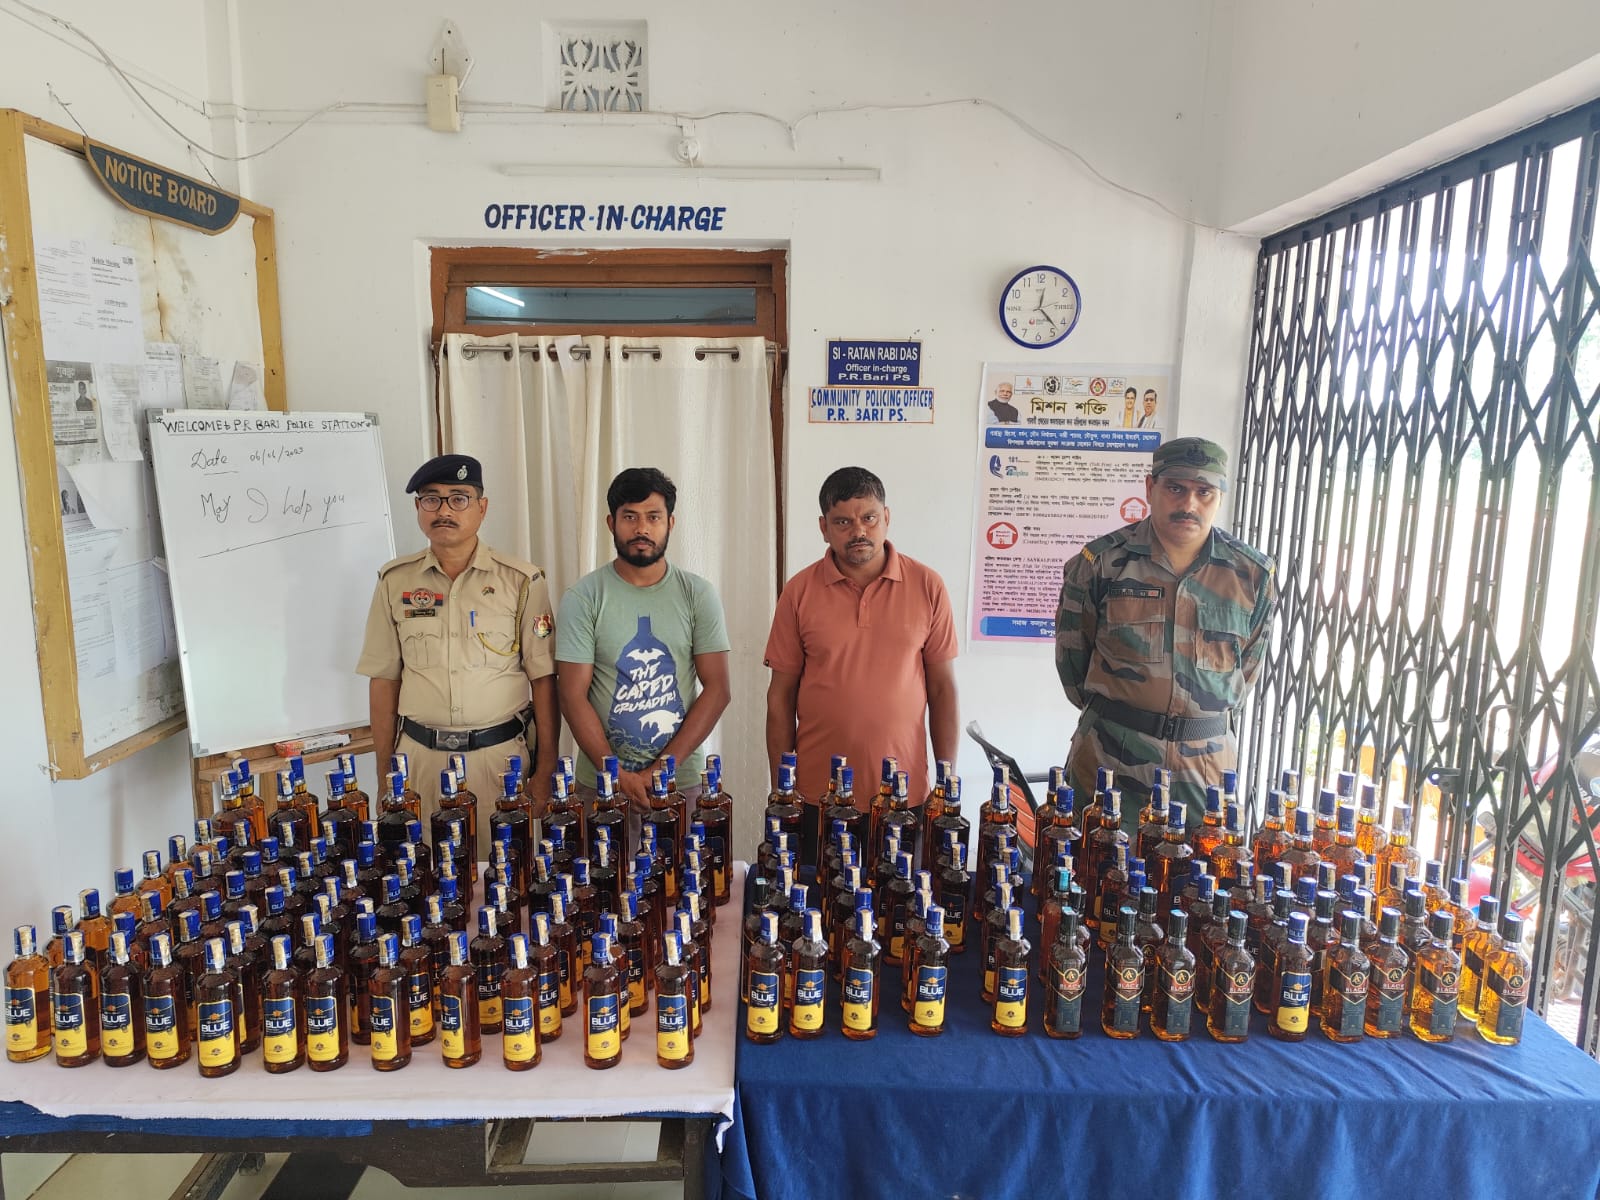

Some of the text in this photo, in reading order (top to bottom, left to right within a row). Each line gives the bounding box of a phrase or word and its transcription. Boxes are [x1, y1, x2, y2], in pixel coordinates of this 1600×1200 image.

[105, 156, 217, 216] NOTICE BOARD
[832, 347, 841, 360] SI
[848, 347, 875, 360] RATAN
[878, 348, 898, 360] RABI
[900, 348, 918, 361] DAS
[845, 363, 871, 372] Officer
[812, 389, 933, 407] COMMUNITY POLICING OFFICER
[1030, 397, 1108, 415] মিশন শক্তি
[827, 408, 849, 421] P.R.
[856, 408, 883, 421] BARI
[163, 420, 222, 433] WELCOME
[256, 420, 279, 431] BARI
[191, 448, 229, 470] Date
[201, 492, 231, 523] May
[283, 487, 312, 521] help
[321, 494, 345, 525] you
[629, 661, 661, 681] THE
[615, 674, 673, 700] CAPED
[613, 690, 676, 714] CRUSADER!
[751, 991, 775, 1001] BLUE
[797, 989, 822, 999] BLUE
[845, 986, 869, 999] BLUE
[919, 985, 944, 995] BLUE
[1000, 986, 1025, 996] BLUE
[1283, 991, 1308, 1001] BLUE
[102, 1014, 127, 1024] BLUE
[146, 1016, 171, 1026] BLUE
[265, 1018, 292, 1028] BLUE
[308, 1017, 333, 1027] BLUE
[505, 1017, 530, 1027] BLUE
[592, 1015, 617, 1026] BLUE
[659, 1015, 683, 1025] BLUE
[201, 1020, 230, 1033] BLUE
